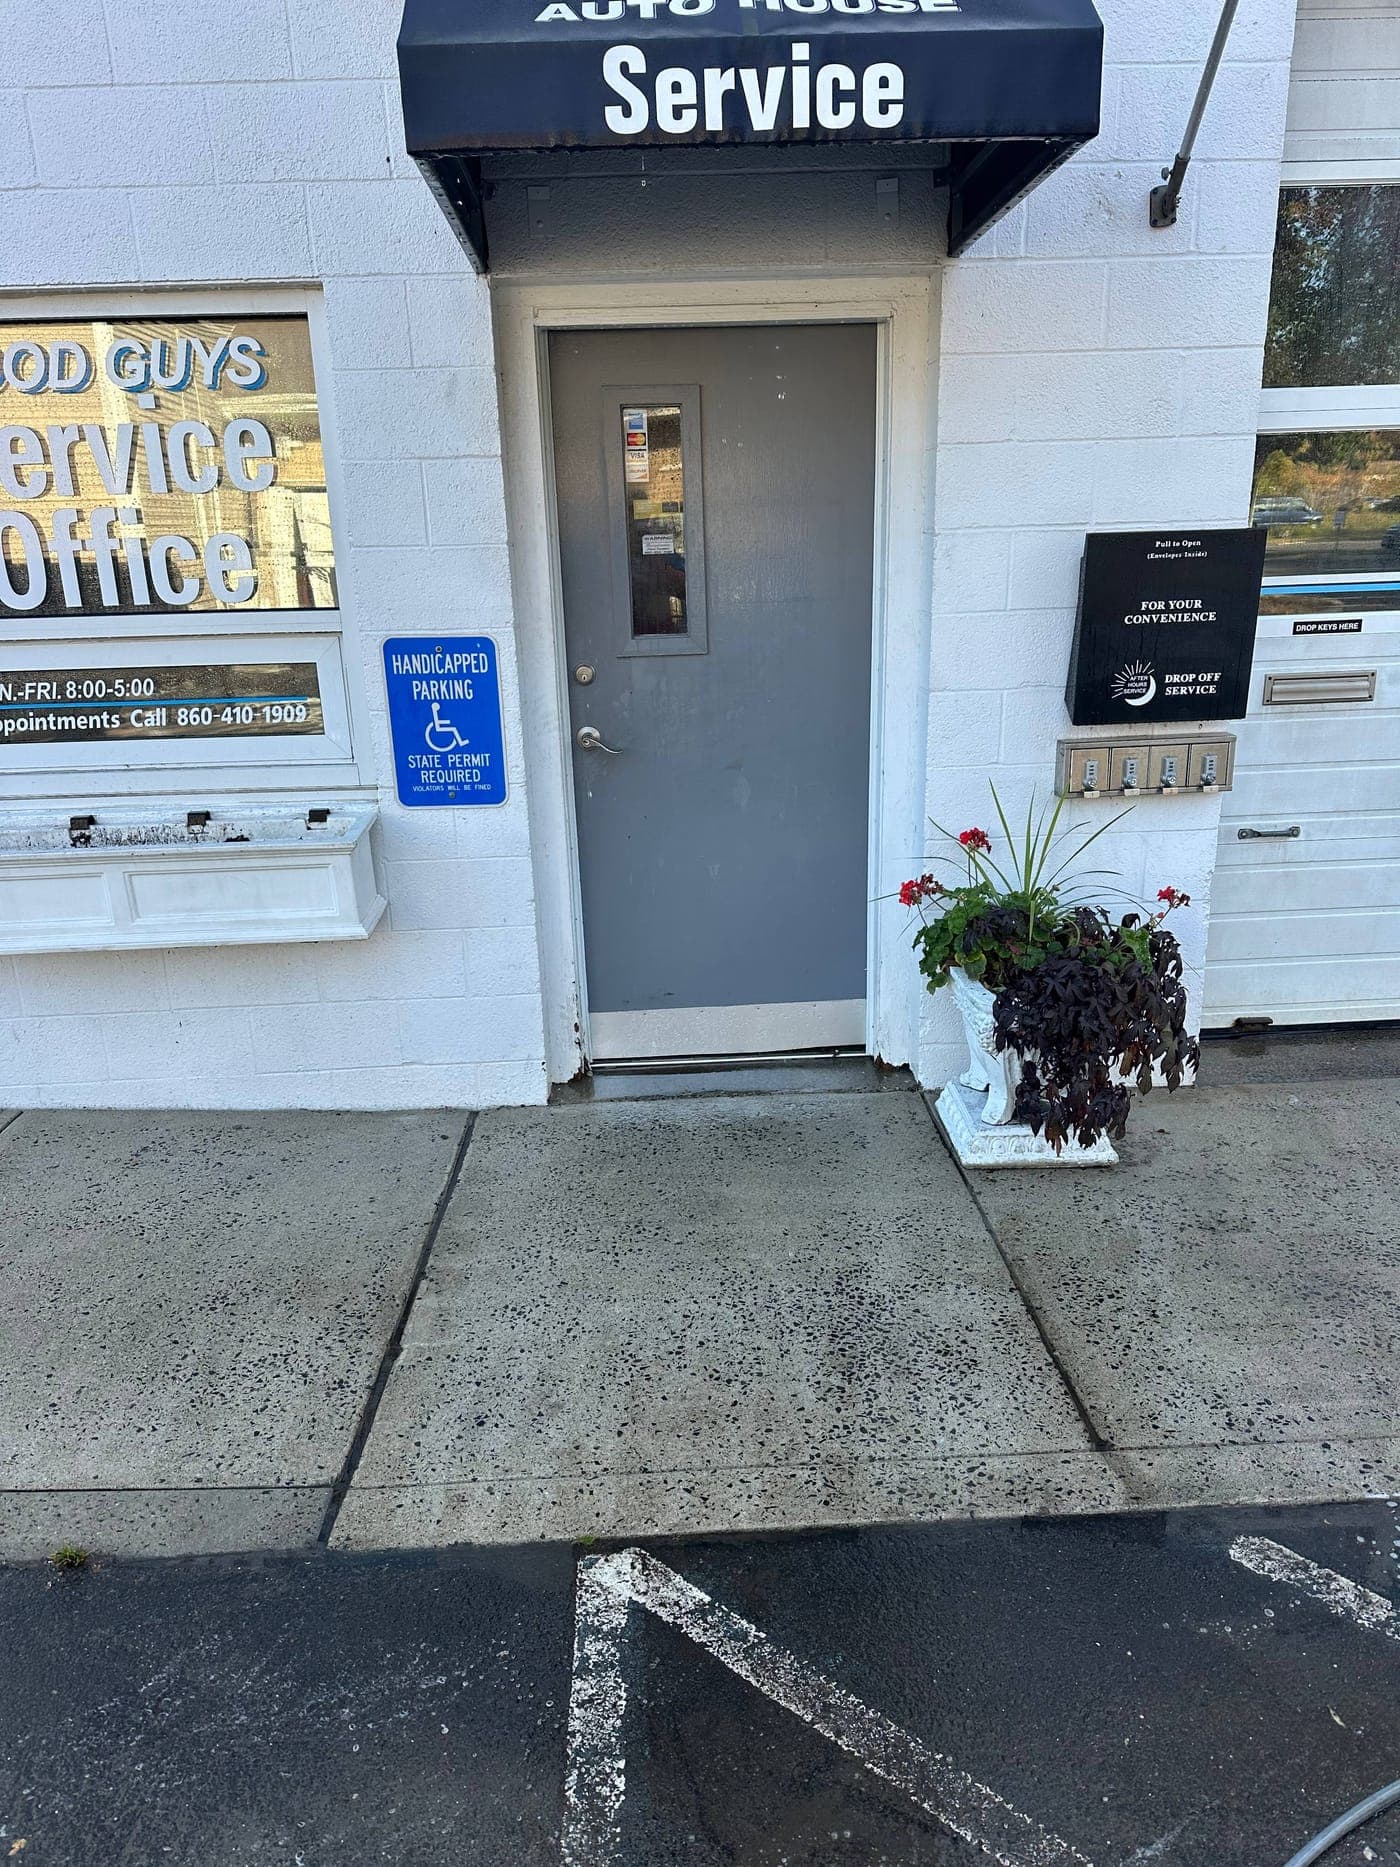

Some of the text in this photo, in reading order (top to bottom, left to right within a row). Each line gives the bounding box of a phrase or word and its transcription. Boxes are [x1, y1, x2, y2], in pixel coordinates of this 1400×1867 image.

[534, 0, 715, 22] AUTO
[602, 42, 905, 135] Service
[0, 336, 268, 395] OD GUYS
[1155, 540, 1171, 548] Pull
[1182, 540, 1201, 548] Open
[0, 507, 258, 611] Office
[1140, 599, 1203, 611] FOR YOUR
[1124, 611, 1217, 625] CONVENIENCE
[1295, 622, 1359, 632] DROP KEYS HERE
[392, 653, 488, 674] HANDICAPPED
[1164, 672, 1222, 684] DROP OFF
[65, 677, 155, 699] 8:00-5:00
[412, 679, 474, 700] PARKING
[1123, 687, 1147, 695] SERVICE
[1164, 684, 1217, 696] SERVICE
[0, 704, 307, 737] pointments Call 860-410-1909
[408, 753, 491, 769] STATE PERMIT
[420, 769, 481, 784] REQUIRED
